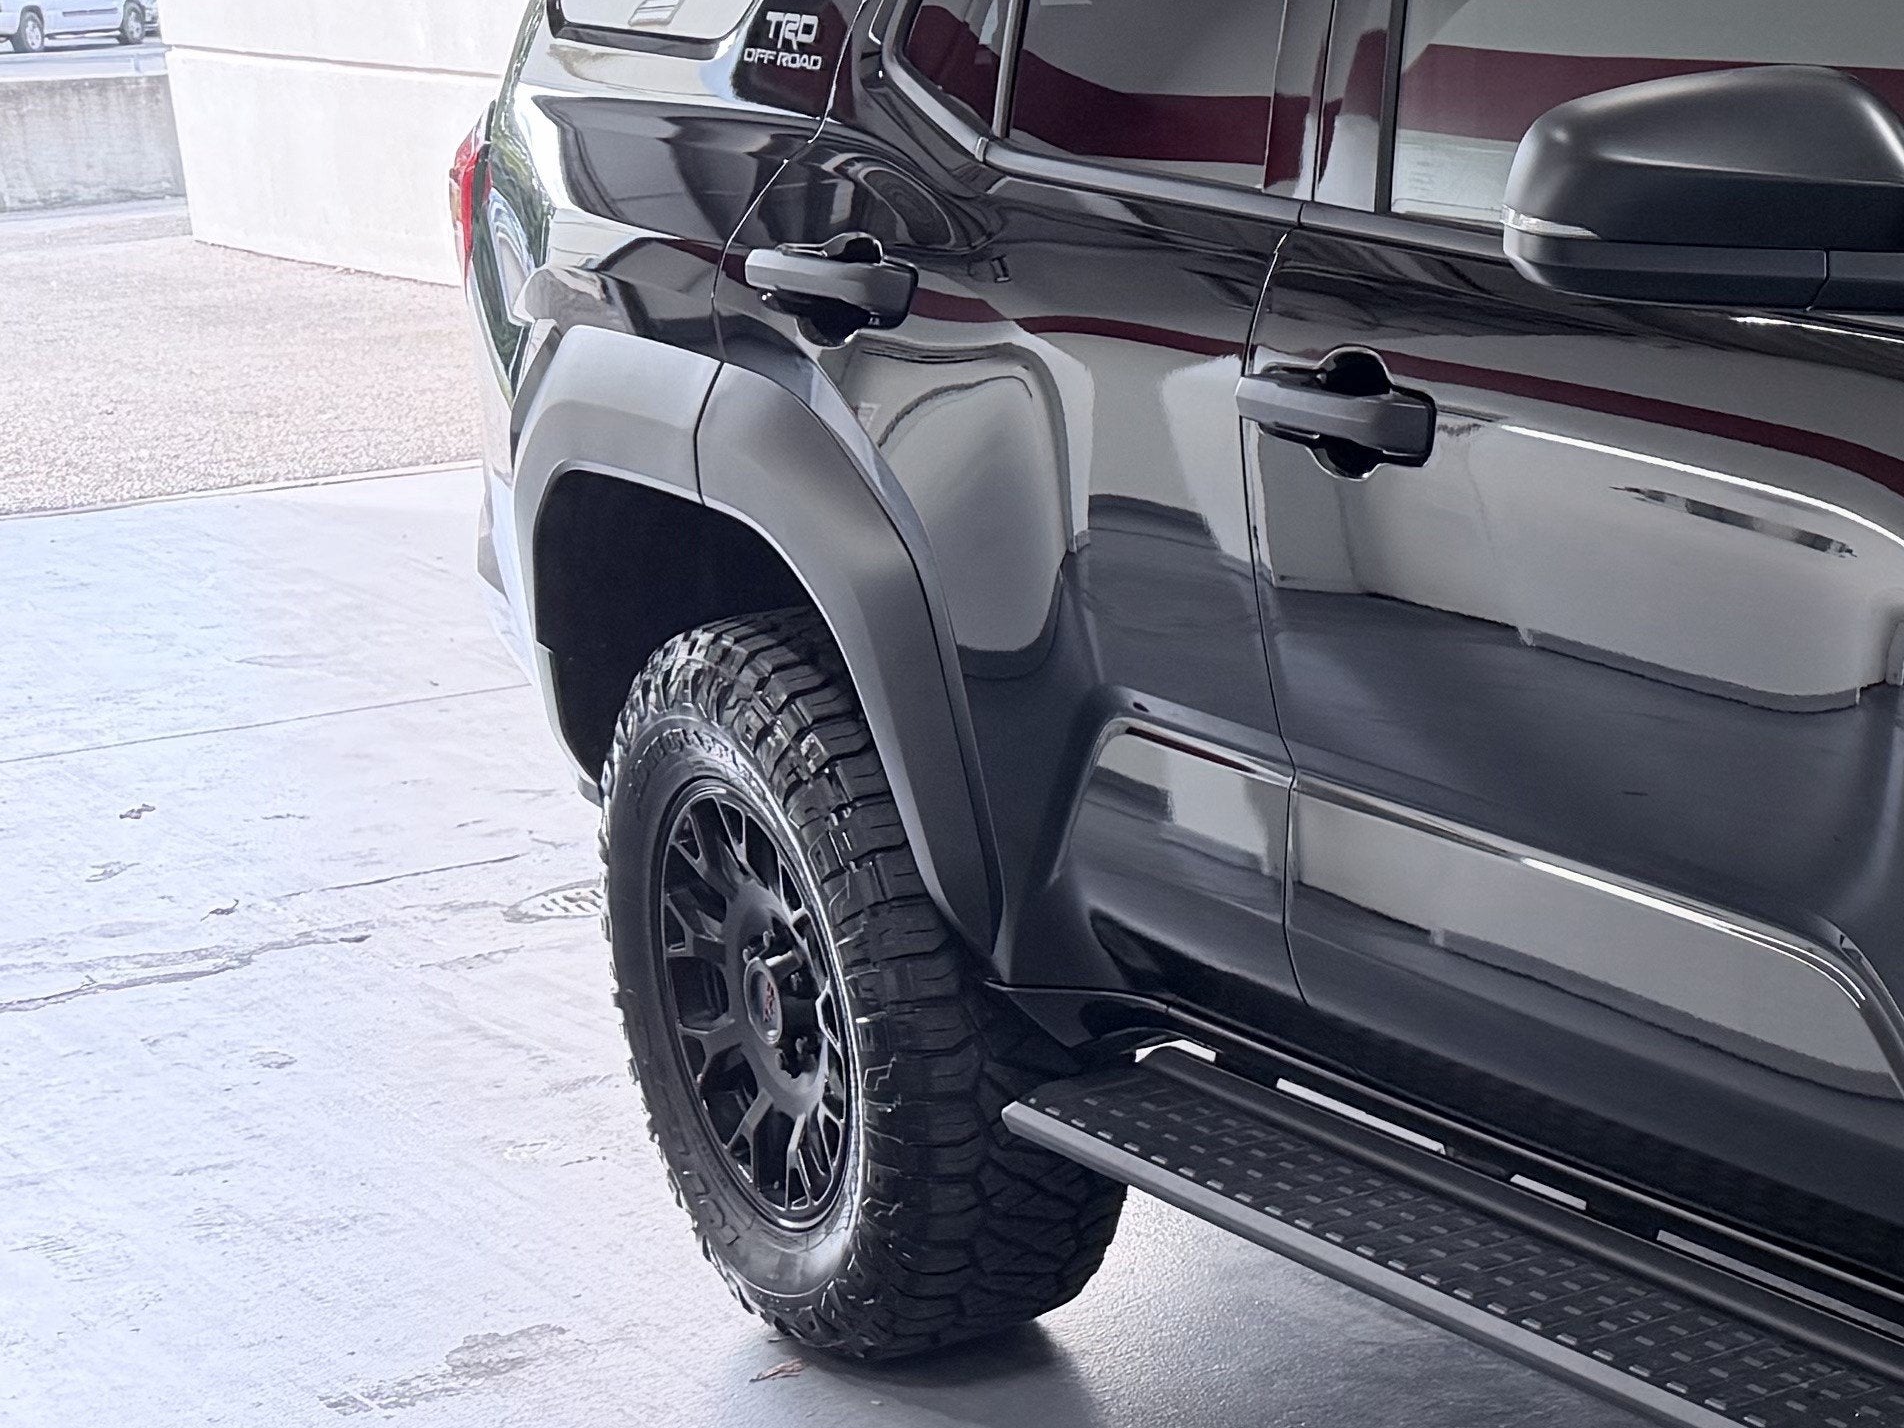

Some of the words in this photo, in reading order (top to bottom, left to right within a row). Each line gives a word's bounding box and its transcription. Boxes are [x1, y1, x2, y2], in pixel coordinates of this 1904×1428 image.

[766, 10, 819, 51] TRD
[744, 47, 776, 65] OFF
[777, 52, 822, 71] ROAD
